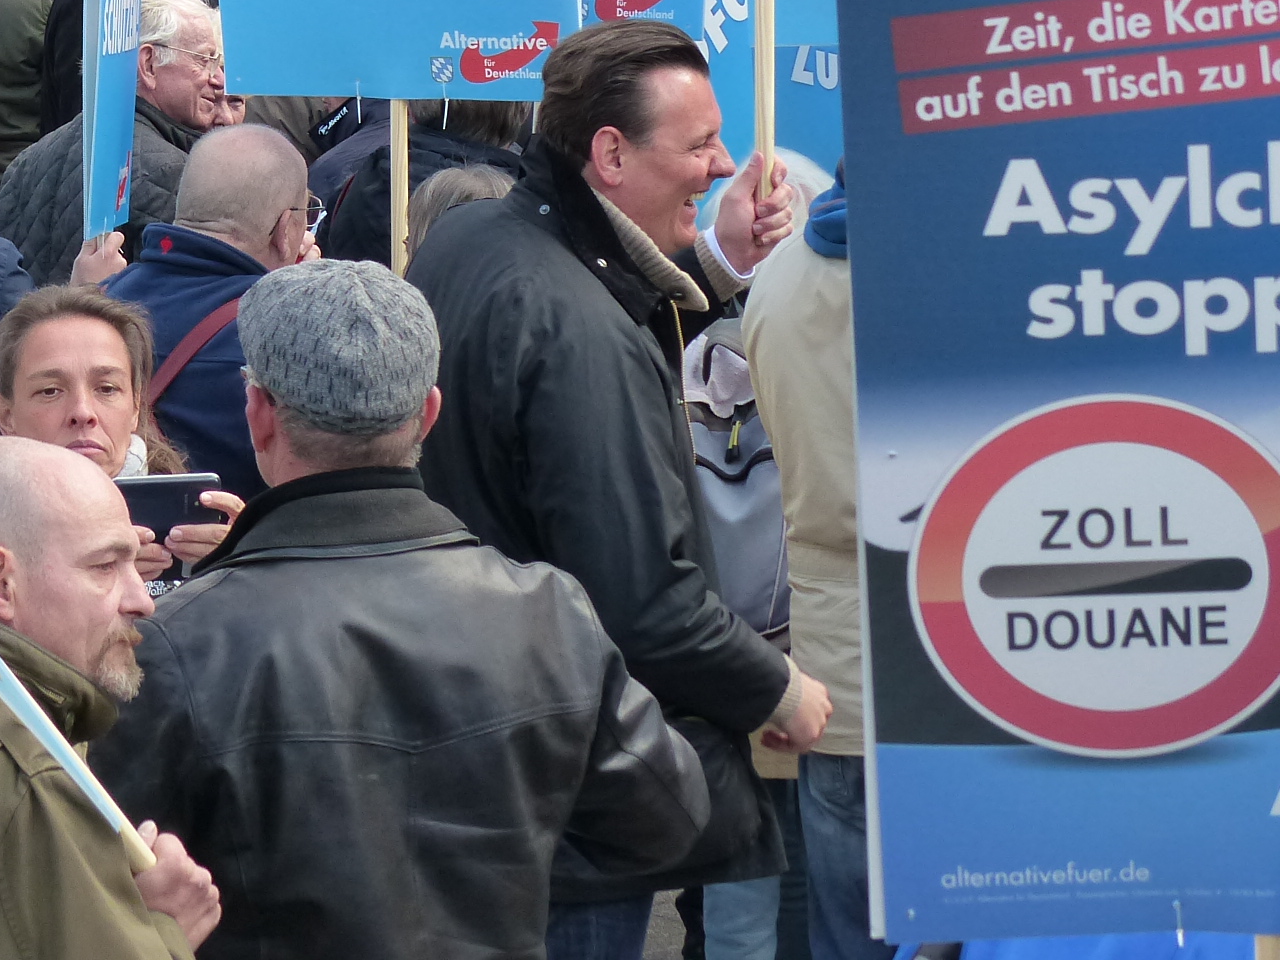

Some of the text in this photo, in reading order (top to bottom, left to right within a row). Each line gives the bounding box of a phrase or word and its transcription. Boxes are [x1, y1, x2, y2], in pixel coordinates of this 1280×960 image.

[616, 0, 627, 7] für
[616, 8, 675, 20] Deutschland
[983, 11, 1074, 54] Zeit,
[1087, 1, 1152, 43] die
[440, 30, 548, 51] Alternative
[484, 58, 495, 67] für
[485, 68, 542, 79] Deutschlan
[915, 75, 983, 122] auf
[995, 71, 1072, 113] den
[1082, 56, 1184, 103] Tisch
[1198, 63, 1246, 92] zu
[1039, 506, 1188, 551] ZOLL
[1006, 605, 1229, 651] DOUANE
[941, 860, 1150, 888] alternativefuer.de
